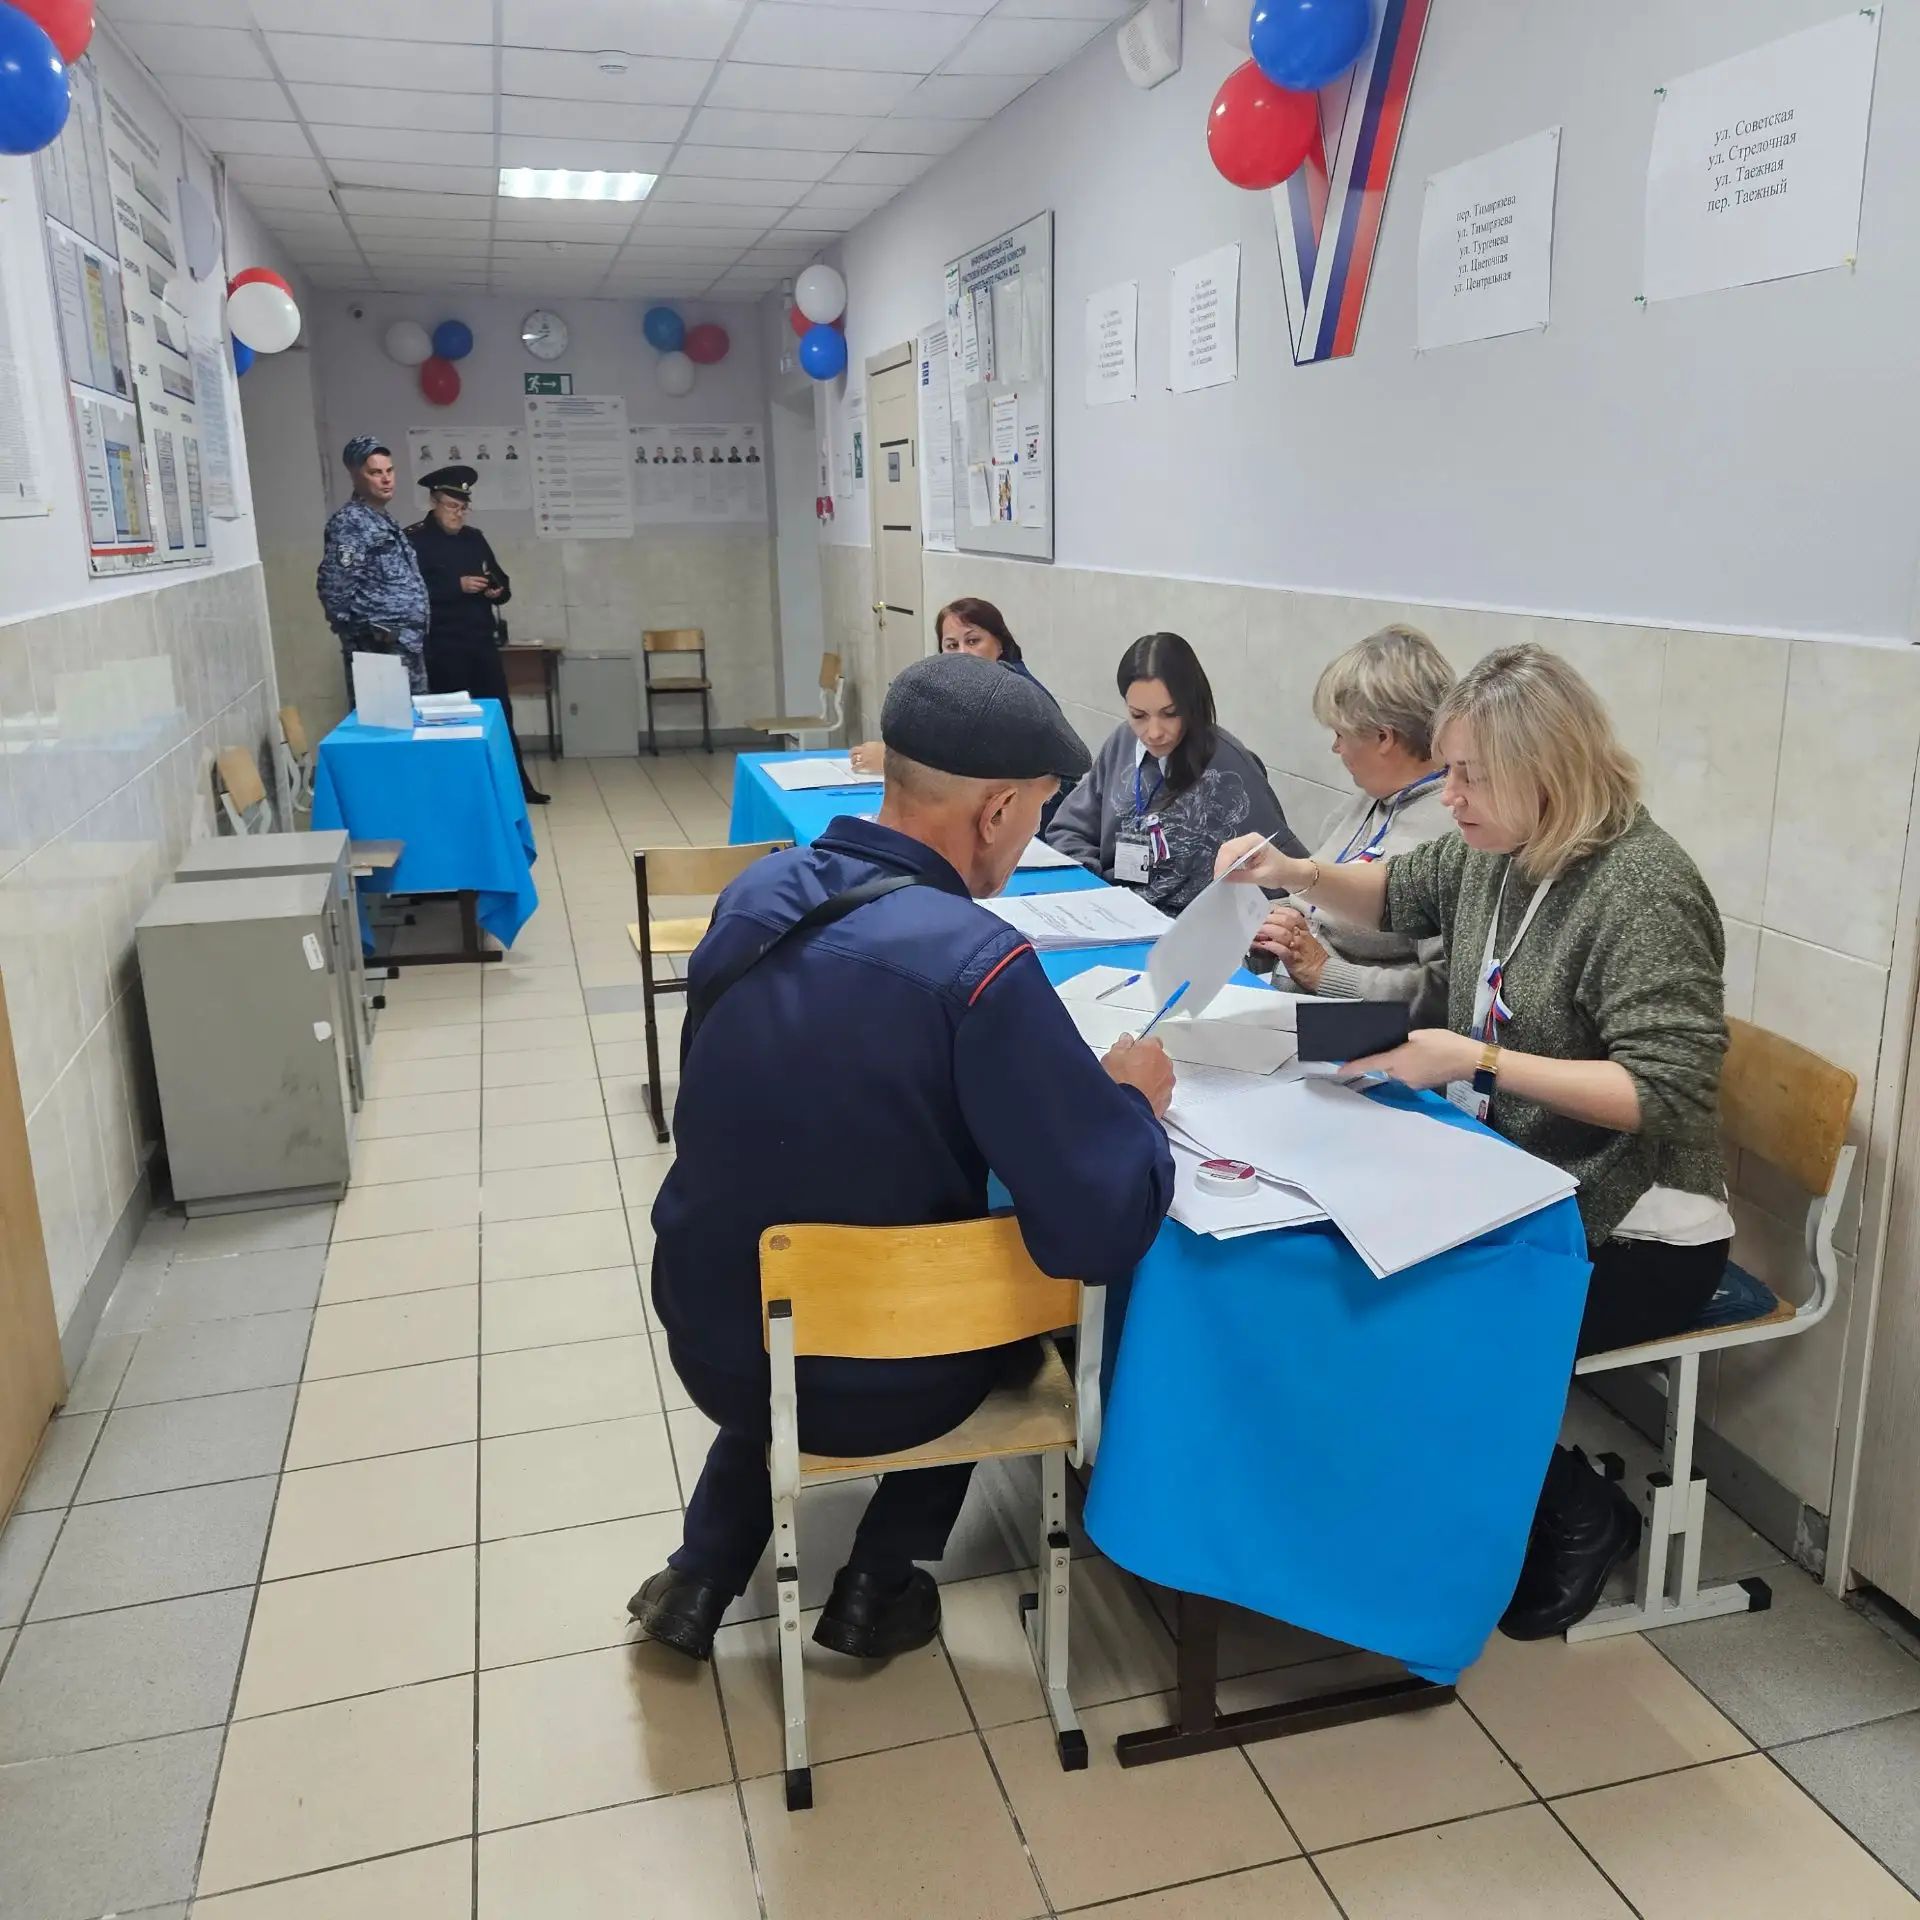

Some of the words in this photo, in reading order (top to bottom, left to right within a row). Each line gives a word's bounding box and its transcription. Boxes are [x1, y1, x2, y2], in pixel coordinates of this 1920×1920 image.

[1714, 129, 1731, 147] ул.
[1735, 109, 1794, 136] Советская
[1707, 153, 1725, 171] ул.
[1728, 132, 1797, 162] Стрелочная
[1714, 174, 1732, 192] ул.
[1736, 159, 1784, 182] Таежная
[1707, 197, 1731, 213] пер.
[1735, 178, 1788, 205] Таежный
[1457, 228, 1468, 242] ул.
[1459, 246, 1471, 260] ул.
[1458, 264, 1469, 278] ул.
